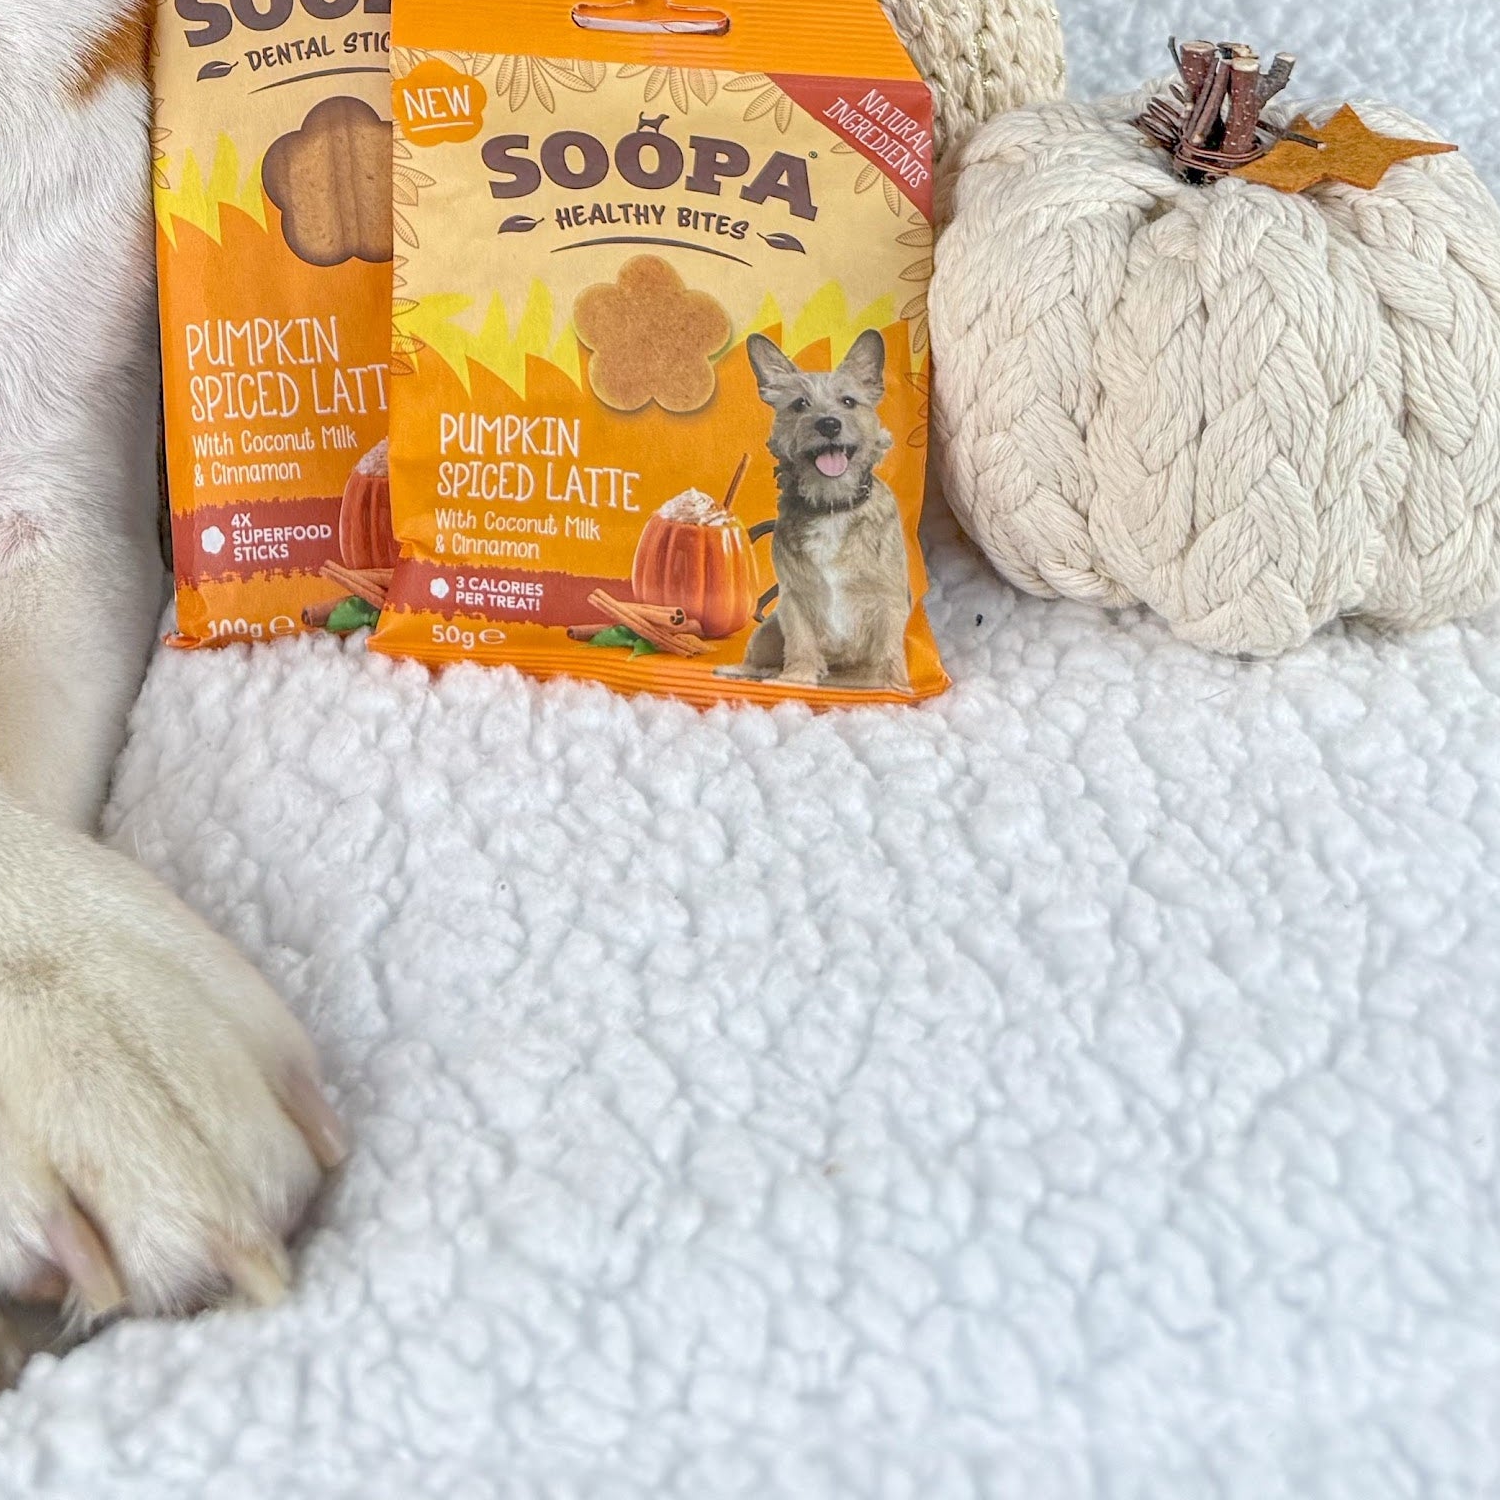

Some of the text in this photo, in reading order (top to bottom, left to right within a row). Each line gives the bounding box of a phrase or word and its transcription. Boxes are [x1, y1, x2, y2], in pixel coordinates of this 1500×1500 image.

[244, 31, 391, 72] DENTAL STIC
[402, 84, 472, 121] NEW
[857, 88, 932, 159] NATURAL
[822, 96, 928, 188] INGREDIENTS
[555, 203, 749, 241] HEALTHY BITES
[185, 315, 339, 370] PUMPKIN
[190, 363, 389, 423] SPICED LATT
[192, 425, 358, 459] With Coconut Milk
[439, 411, 581, 458] PUMPKIN
[194, 462, 301, 488] & Cinnamon
[437, 461, 641, 512] SPICED LATTE
[231, 513, 252, 528] 4X
[232, 524, 332, 546] SUPERFOOD
[435, 507, 601, 541] With Coconut Milk
[233, 546, 289, 563] STICKS
[435, 532, 540, 560] & Cinnamon
[455, 576, 544, 597] 3 CALORIES
[455, 591, 541, 612] PER TREAT!
[431, 624, 475, 649] 50g
